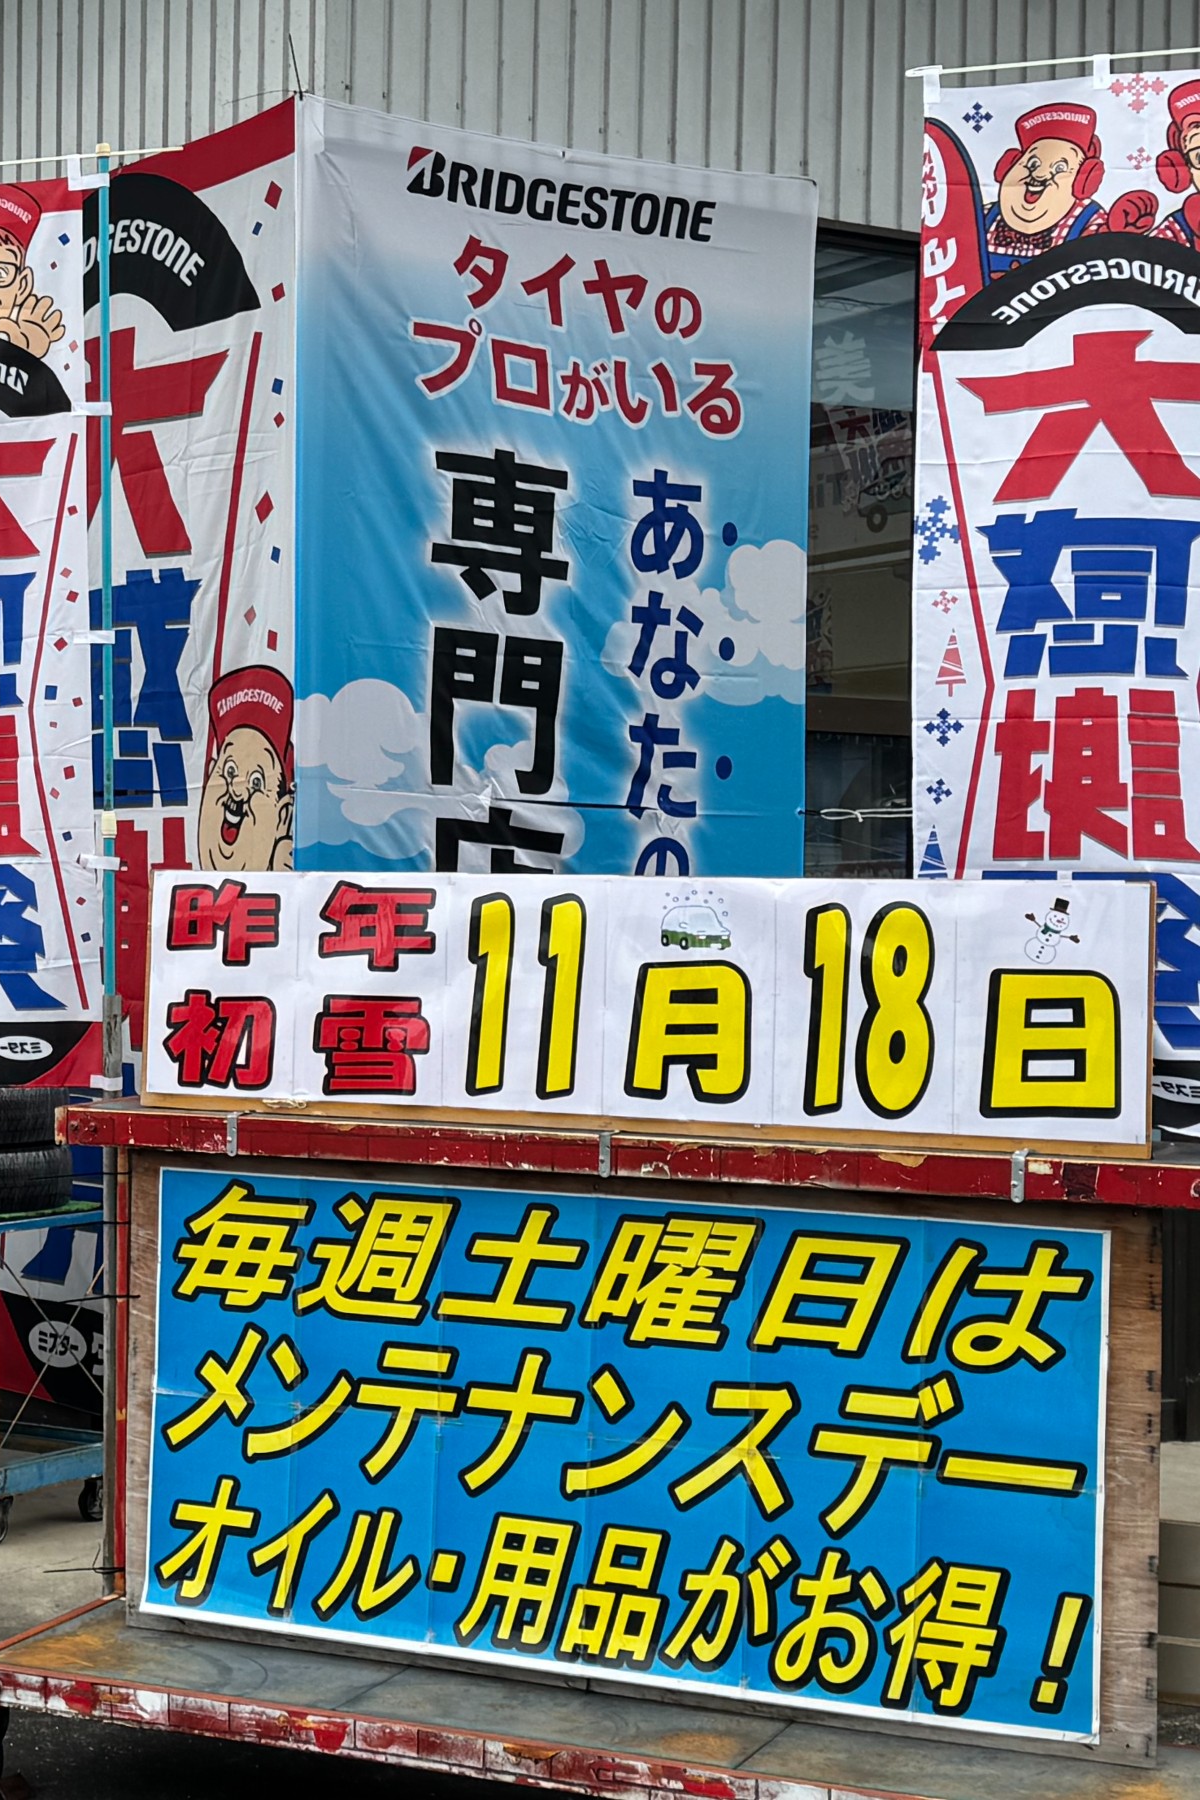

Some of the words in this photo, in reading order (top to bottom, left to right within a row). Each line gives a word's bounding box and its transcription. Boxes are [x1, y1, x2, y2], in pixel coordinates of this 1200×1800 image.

[406, 145, 716, 243] BRIDGESTONE
[453, 233, 702, 339] タイヤの
[412, 318, 742, 435] プロがいる
[216, 688, 285, 718] BRIDGESTONE
[166, 878, 437, 973] 昨年
[162, 989, 431, 1097] 初雪
[464, 890, 1122, 1119] 11月18日
[174, 1179, 1094, 1373] 毎週土曜日は
[162, 1322, 1088, 1540] メンテナンスデー
[154, 1475, 1093, 1716] オイル・用品がお得！
